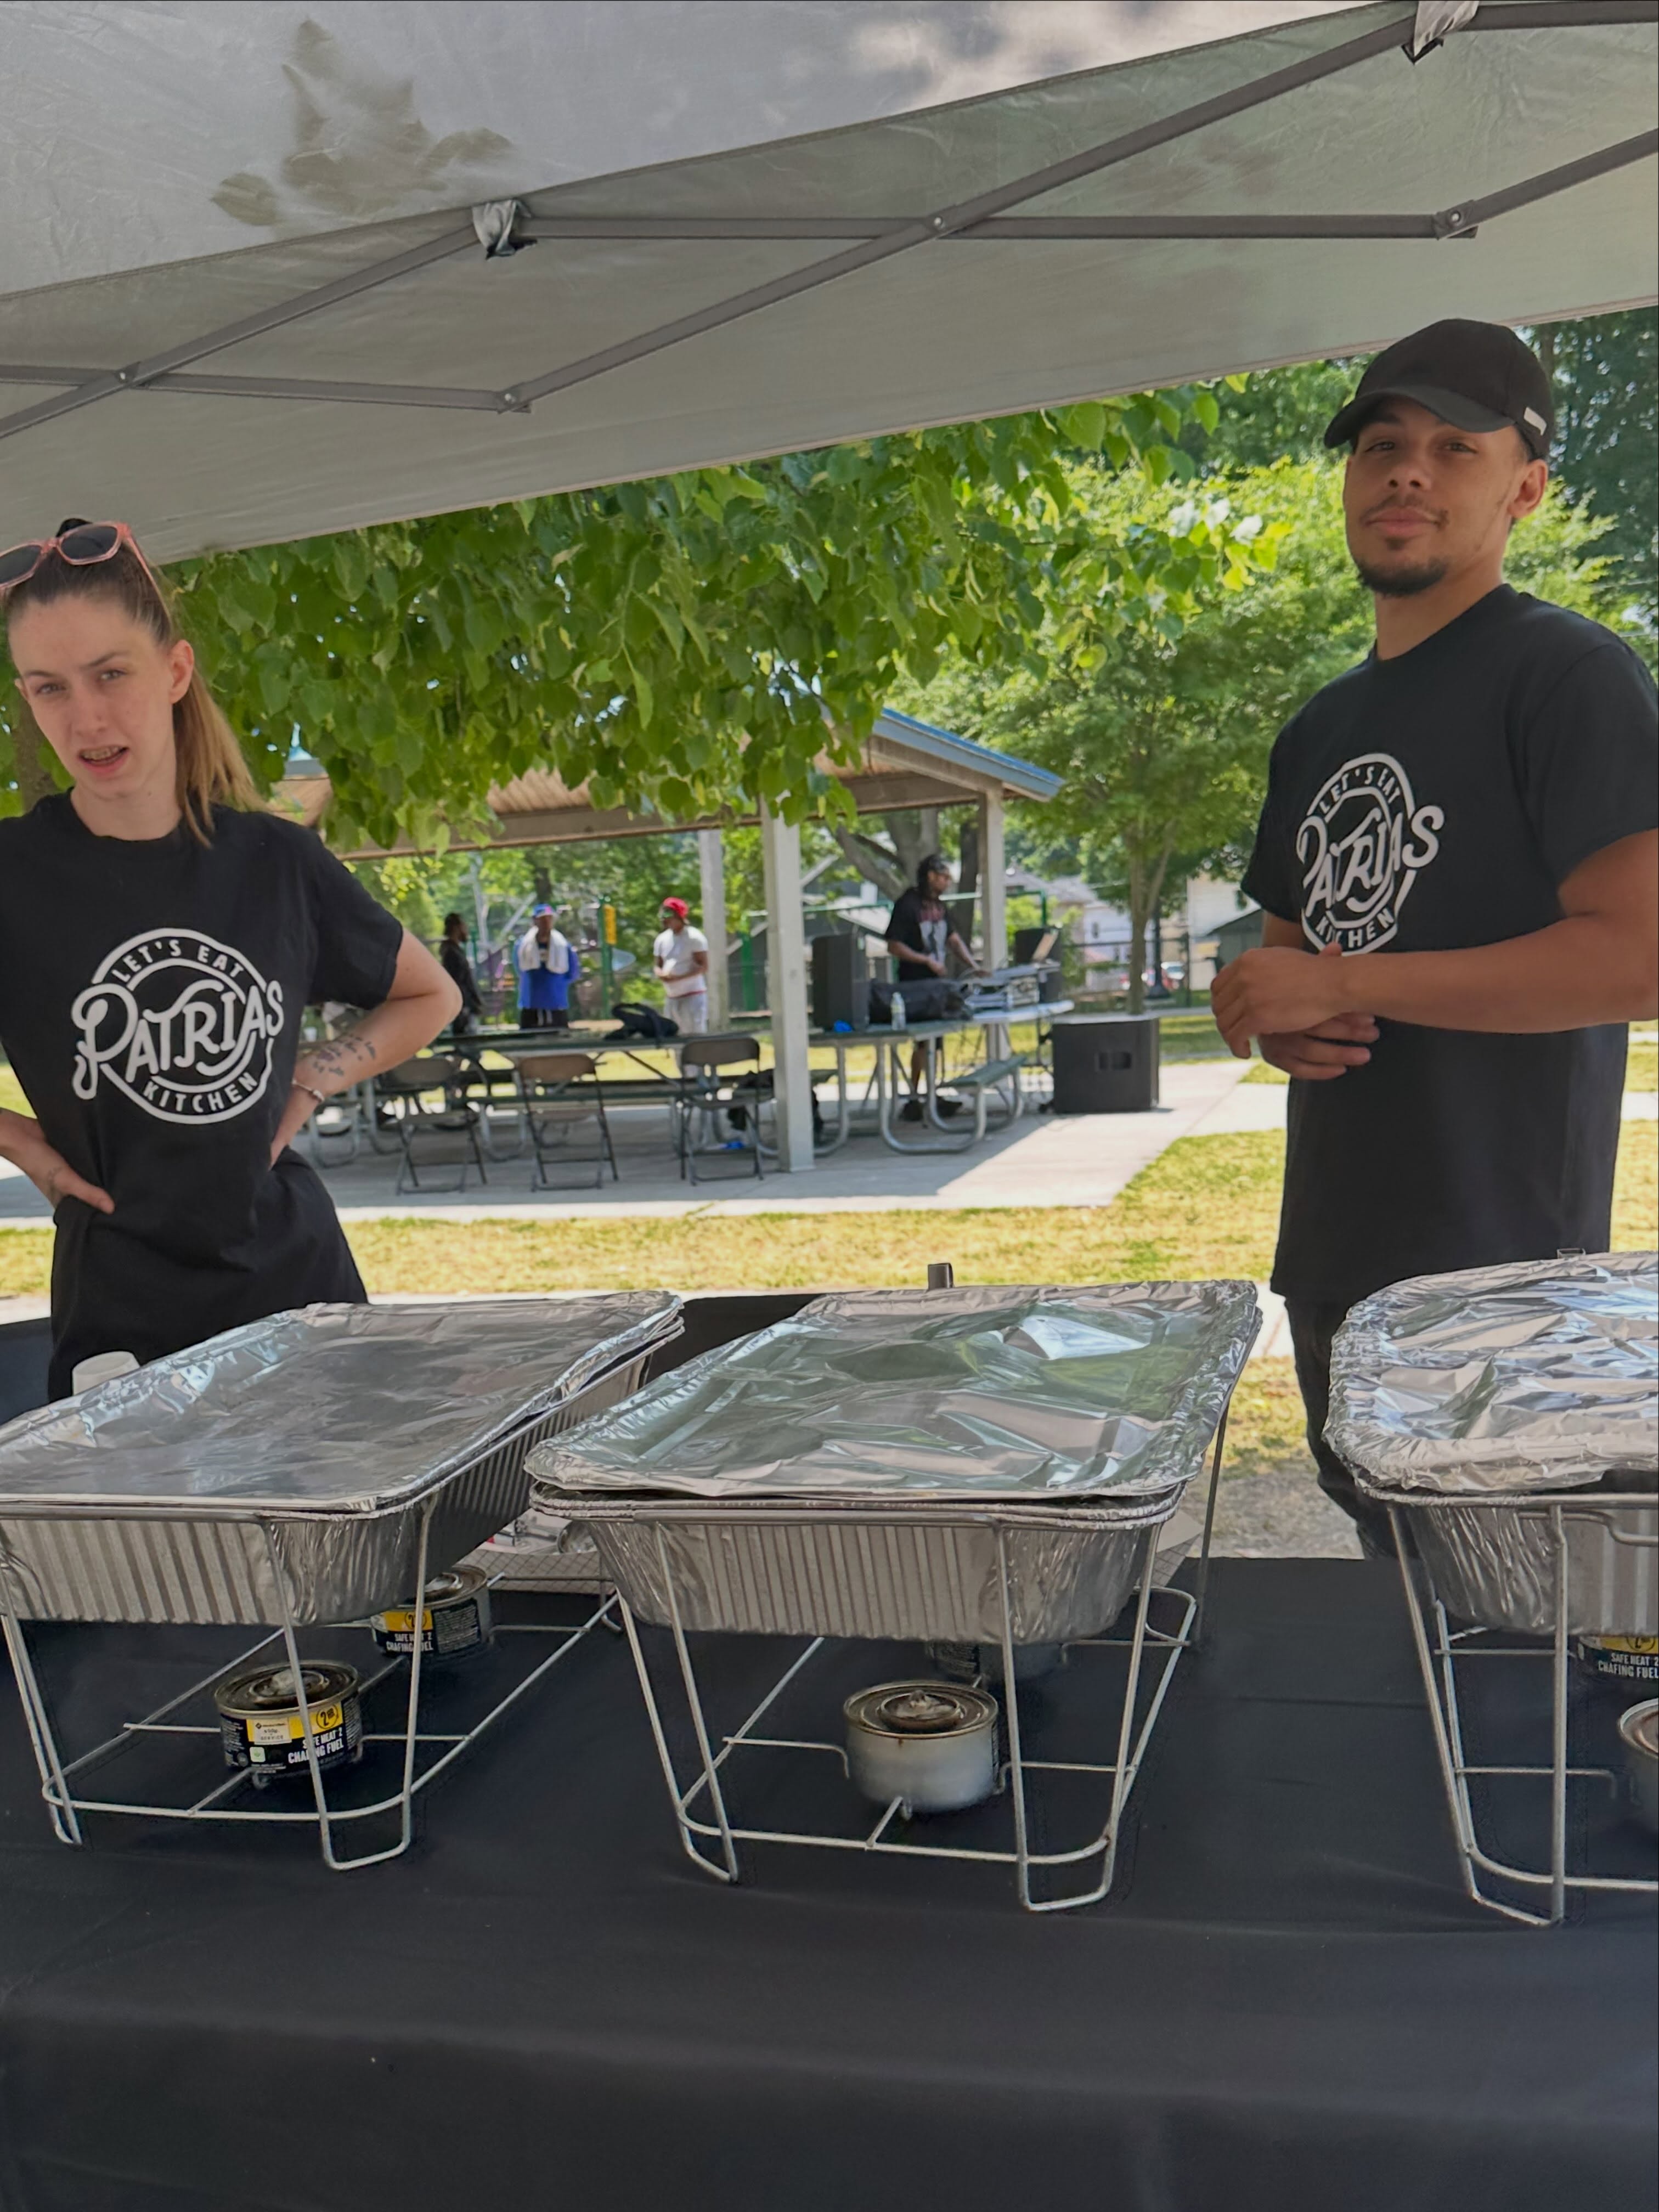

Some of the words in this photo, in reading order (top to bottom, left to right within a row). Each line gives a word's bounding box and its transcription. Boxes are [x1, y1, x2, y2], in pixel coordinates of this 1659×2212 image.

[1319, 766, 1374, 814] LET'S
[1378, 769, 1402, 804] EAT
[111, 939, 182, 983] LET'S
[196, 945, 244, 978] EAT
[71, 979, 284, 1100] PATRIAS
[143, 1072, 258, 1113] KITCHEN
[1598, 1660, 1634, 1677] CHAFING
[1637, 1667, 1659, 1679] FUEL
[1611, 1652, 1629, 1664] SAFE
[1630, 1655, 1650, 1666] HEAT
[326, 1737, 344, 1754] FUEL
